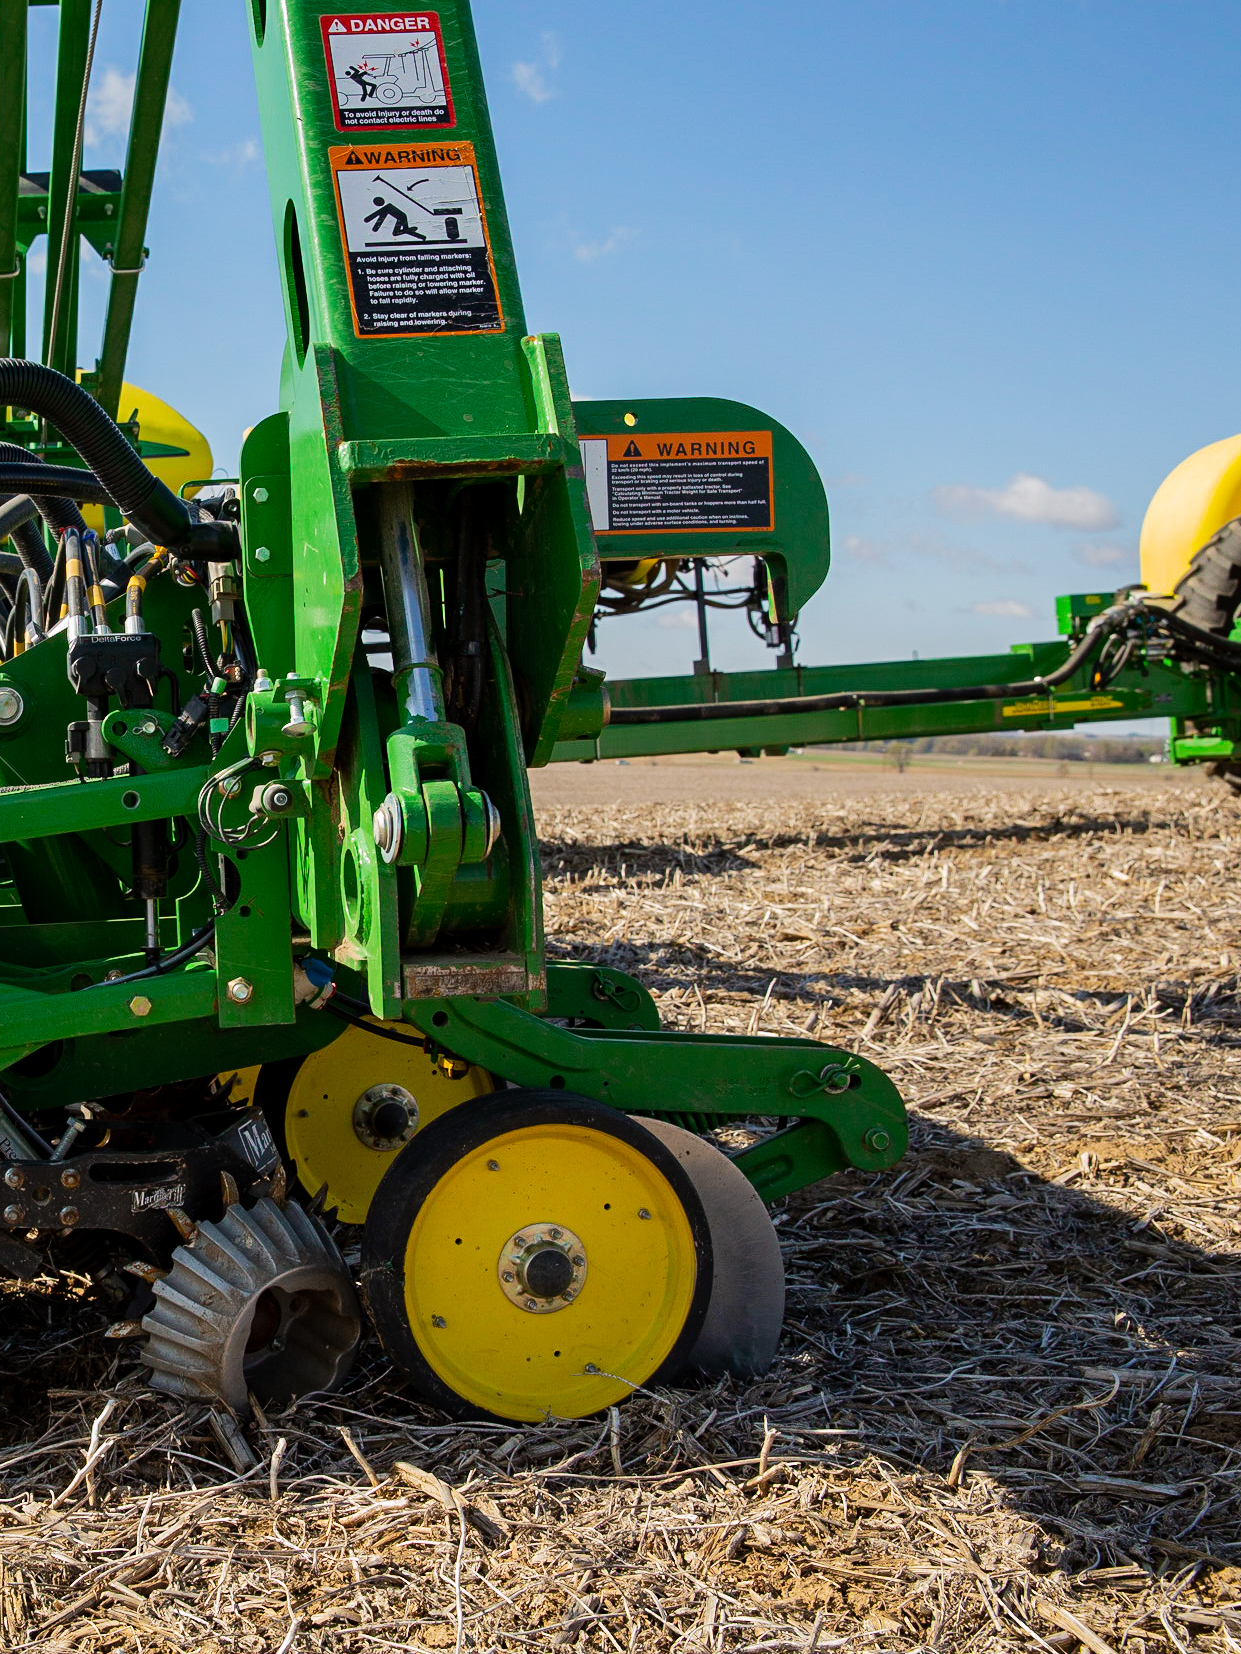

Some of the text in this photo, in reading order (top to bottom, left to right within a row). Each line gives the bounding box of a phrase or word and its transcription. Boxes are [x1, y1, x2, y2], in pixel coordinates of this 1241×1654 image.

[350, 17, 430, 32] DANGER
[364, 150, 460, 164] WARNING
[657, 441, 756, 456] WARNING
[92, 636, 142, 644] DeltaForce
